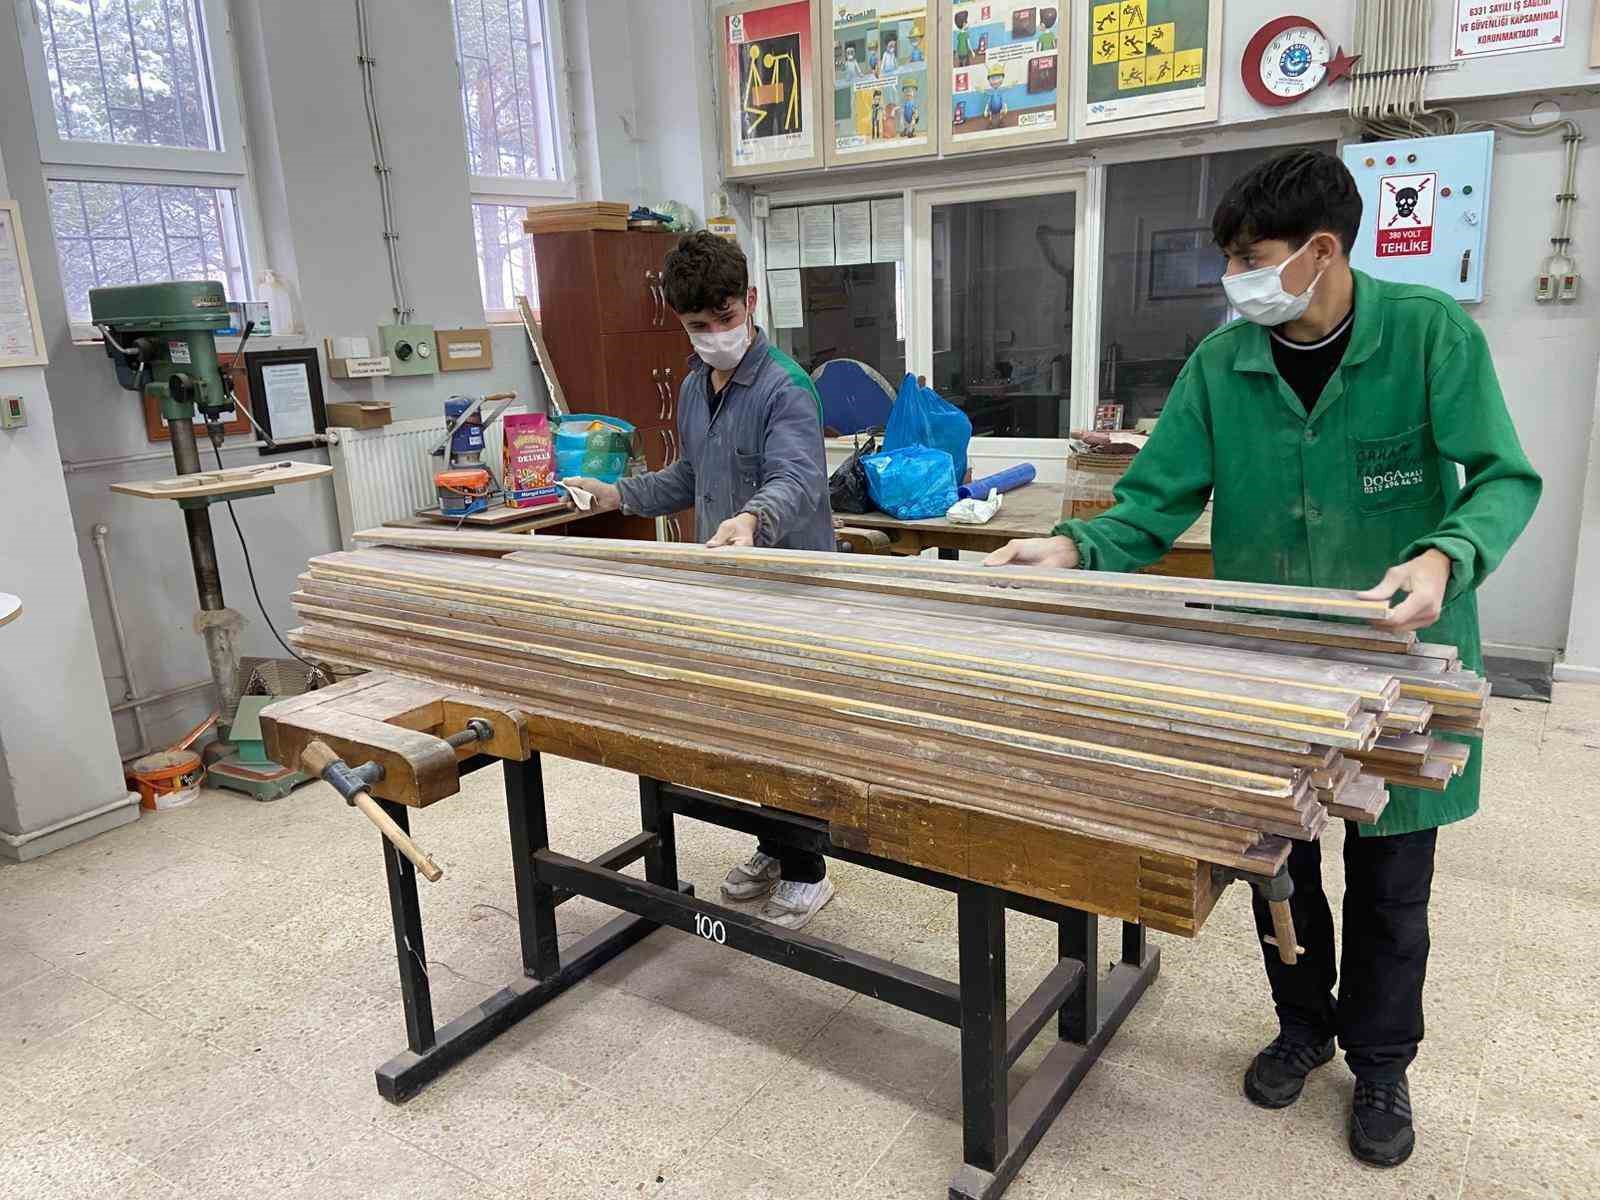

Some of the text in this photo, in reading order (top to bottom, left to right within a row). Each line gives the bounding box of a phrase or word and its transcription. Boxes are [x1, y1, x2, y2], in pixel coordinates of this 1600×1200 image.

[1469, 7, 1487, 17] 6331
[1489, 3, 1512, 14] SAYILI
[1460, 23, 1469, 32] VE
[1511, 11, 1558, 25] KAPSAMINDA
[1478, 29, 1538, 44] KORUNMAKTADIR
[1402, 230, 1421, 238] VOLT
[1380, 240, 1429, 254] TEHLİKE
[694, 912, 726, 944] 100
